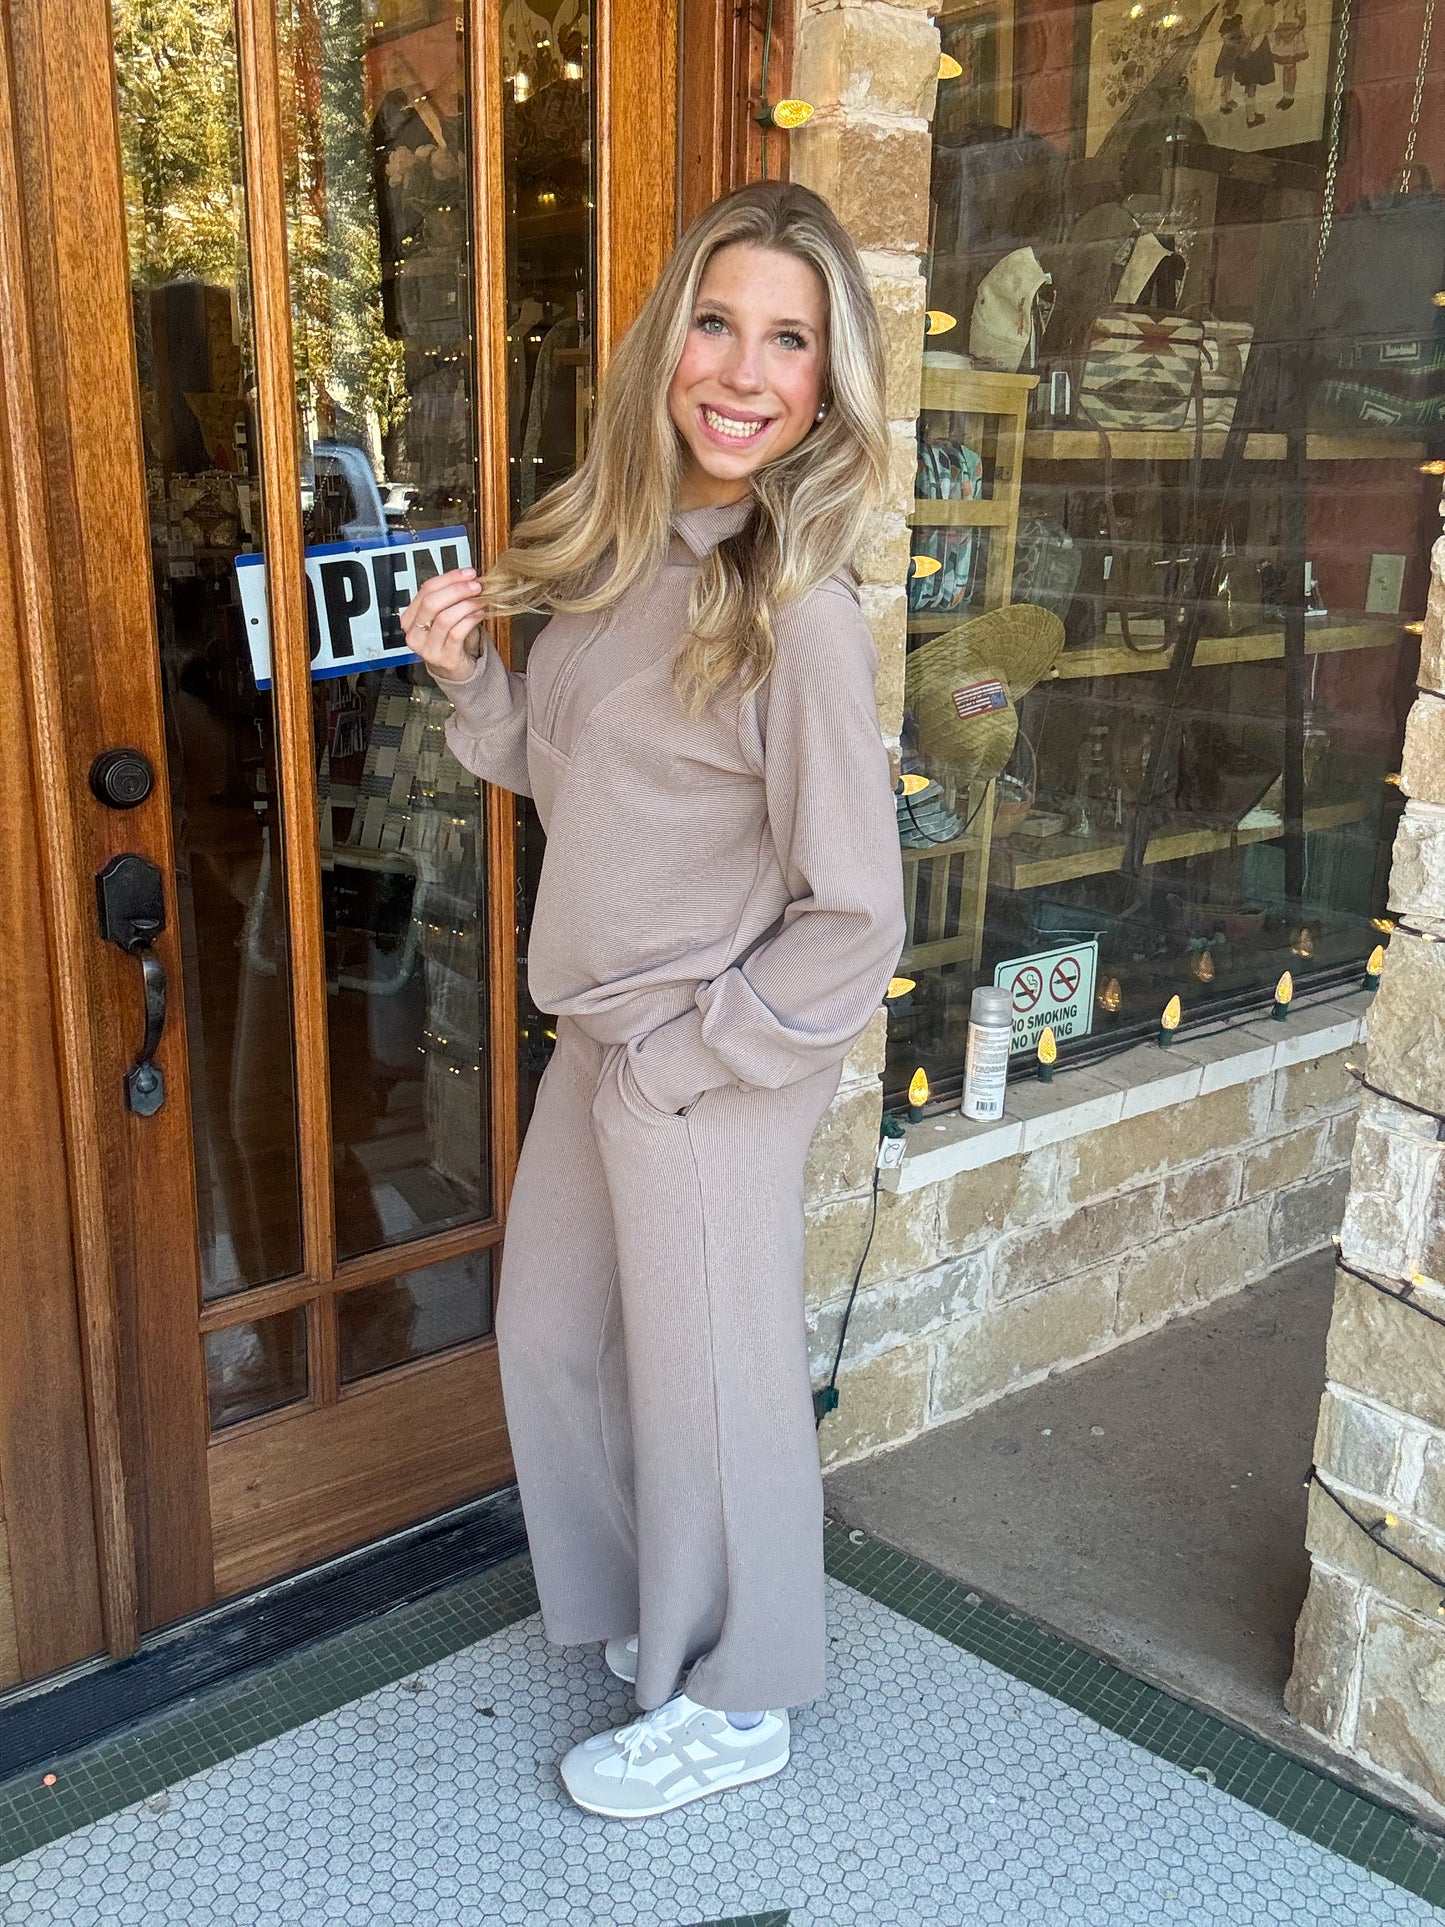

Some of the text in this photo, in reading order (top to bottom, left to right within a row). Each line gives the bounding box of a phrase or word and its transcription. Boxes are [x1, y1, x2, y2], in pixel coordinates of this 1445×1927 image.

[305, 546, 459, 661] PE
[1027, 1005, 1077, 1029] SMOKING
[1011, 1035, 1027, 1051] NO
[1031, 1023, 1073, 1045] VING
